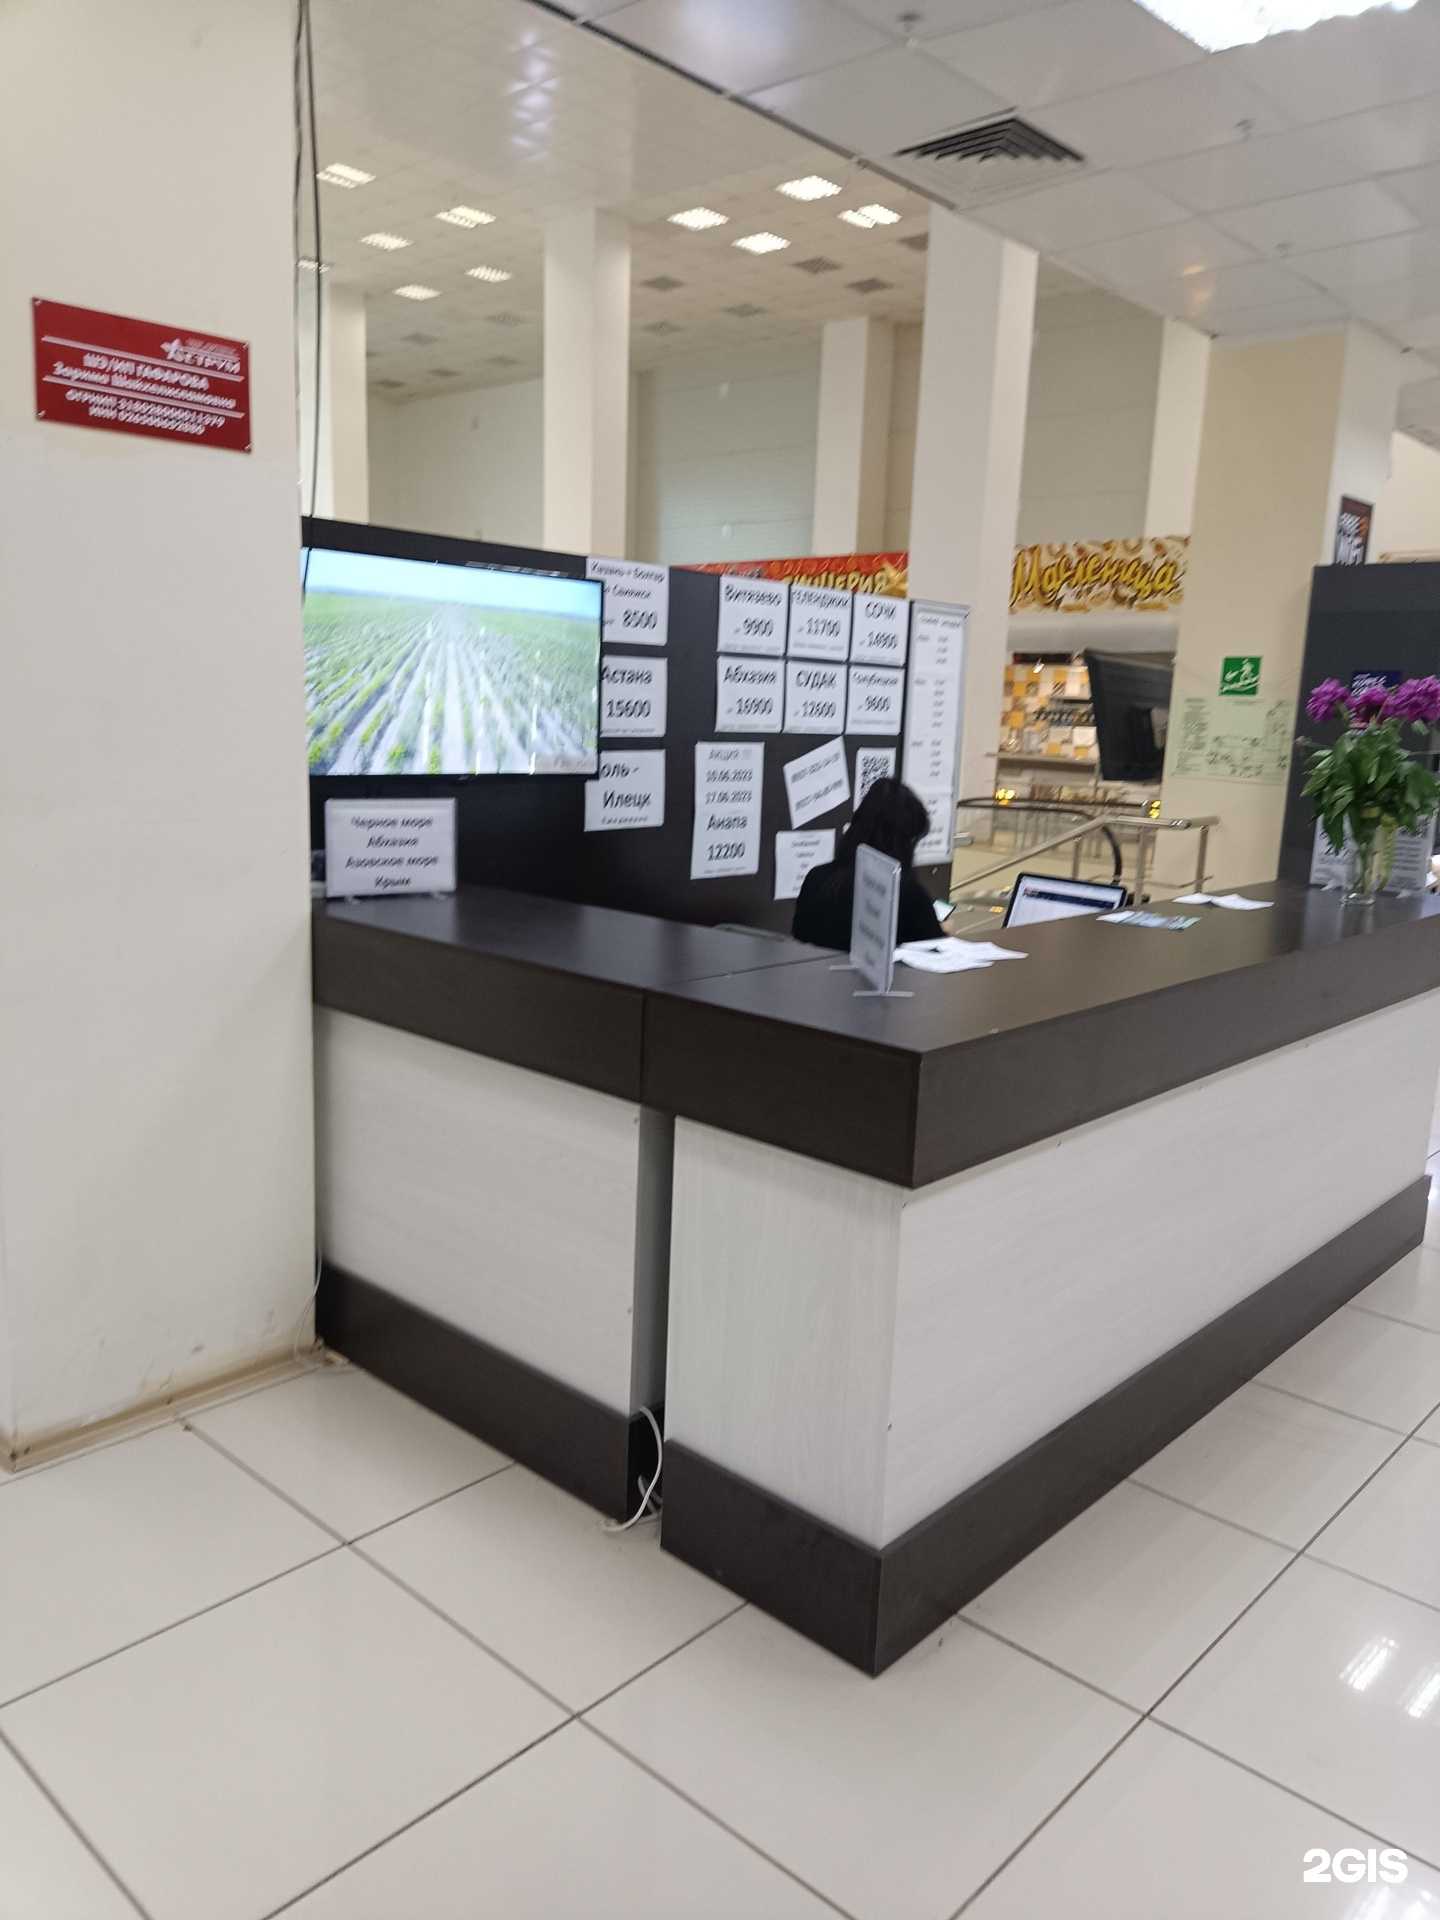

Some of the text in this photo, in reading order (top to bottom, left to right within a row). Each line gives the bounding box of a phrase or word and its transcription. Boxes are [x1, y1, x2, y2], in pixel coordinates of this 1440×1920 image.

[725, 584, 783, 606] Витязево
[623, 609, 657, 630] 8500
[743, 618, 773, 637] 9900
[805, 617, 840, 637] 11700
[601, 666, 653, 685] Астана
[723, 664, 777, 686] Абхазия
[796, 670, 838, 690] СУДАК
[607, 699, 651, 718] 15600
[603, 790, 652, 810] Илецк
[706, 814, 748, 831] Анапа
[707, 842, 745, 861] 12200
[374, 875, 412, 889] Крым
